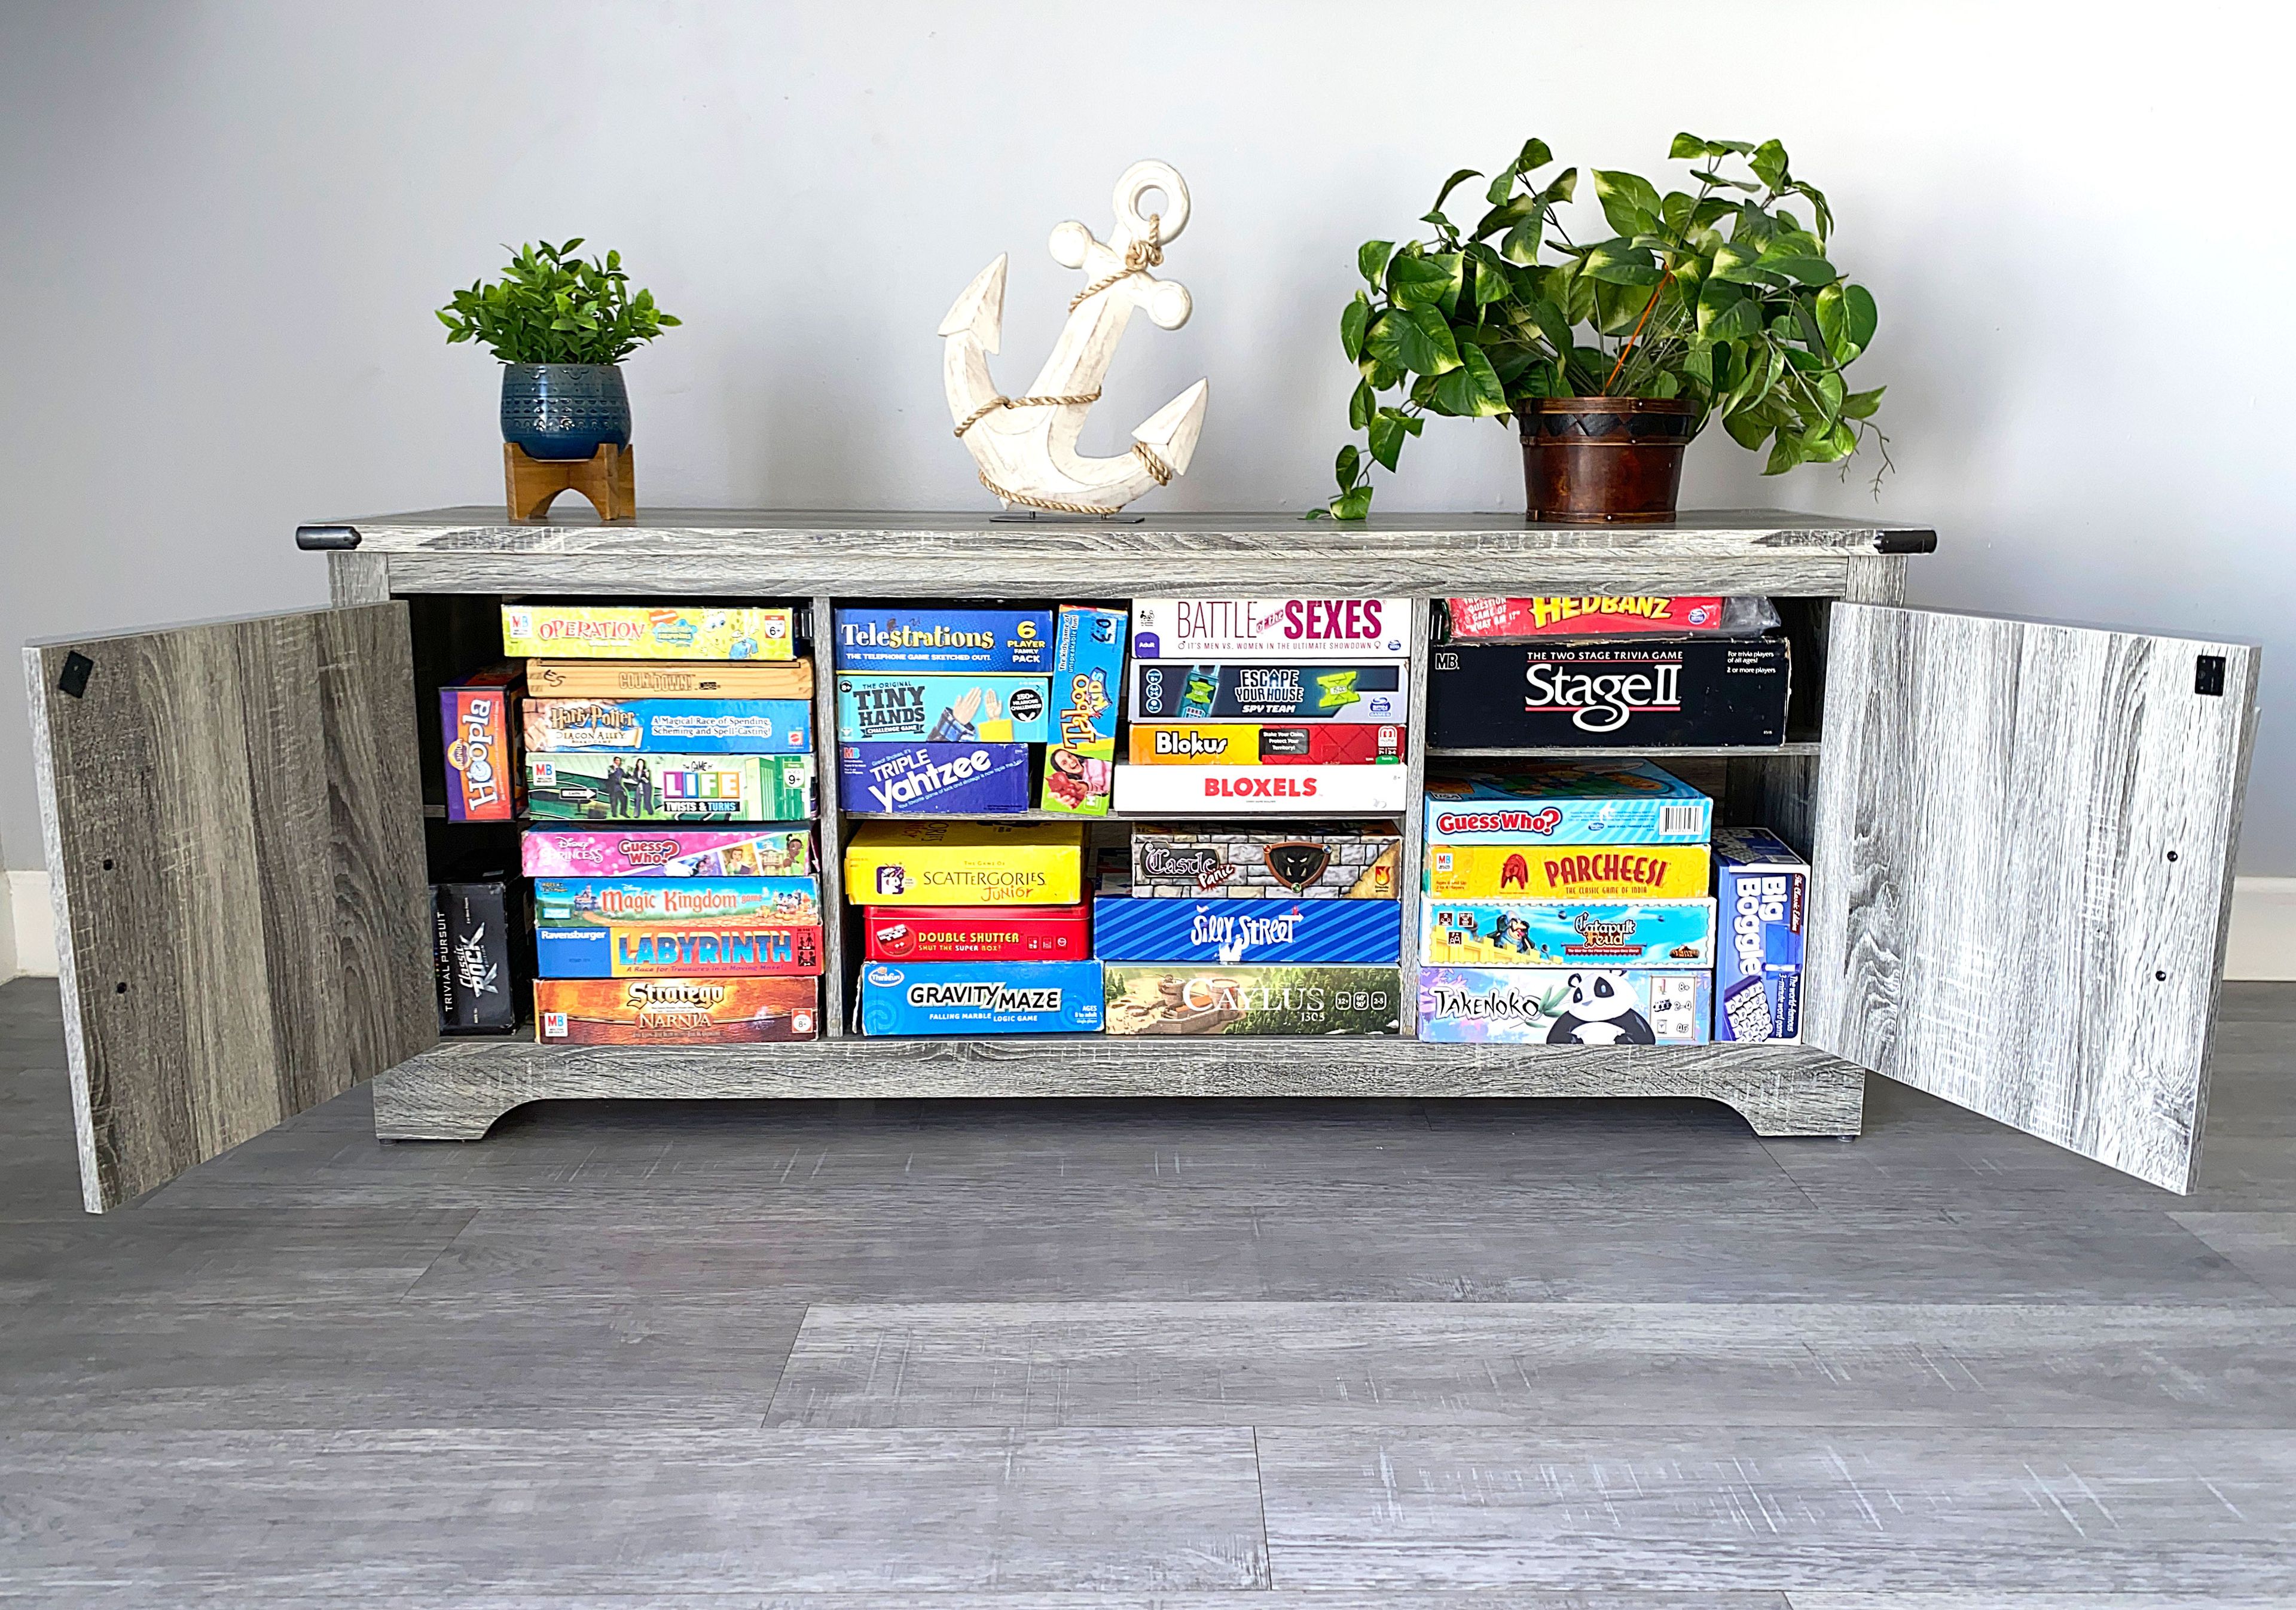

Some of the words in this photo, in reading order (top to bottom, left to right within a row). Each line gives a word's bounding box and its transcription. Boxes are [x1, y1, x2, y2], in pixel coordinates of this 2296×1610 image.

[1177, 601, 1257, 638] BATTLE
[1284, 599, 1382, 640] SEXES
[1495, 604, 1507, 615] OF
[1528, 597, 1672, 629] HEDBANZ
[512, 615, 529, 628] MB
[539, 619, 645, 638] OPERATION
[769, 626, 781, 636] 6+
[1016, 621, 1037, 639] 6
[841, 622, 995, 649] Telestrations
[1068, 631, 1077, 673] unspeakable
[1527, 652, 1547, 660] THE
[1550, 652, 1575, 660] TWO
[1578, 651, 1611, 660] STAGE
[1614, 651, 1648, 660] TRIVIA
[1651, 650, 1683, 659] GAME
[1241, 670, 1299, 688] ESCAPE
[853, 686, 926, 710] TINY
[1236, 688, 1265, 701] YOUR
[1267, 688, 1303, 701] HOUSE
[1525, 663, 1652, 732] Stage
[858, 707, 926, 726] HANDS
[1060, 673, 1095, 749] Taboo
[1242, 704, 1263, 713] SPY
[1266, 704, 1296, 713] TEAM
[551, 707, 590, 731] Harry
[590, 704, 635, 734] Potter
[661, 717, 694, 726] Magical
[654, 727, 694, 736] Scheming
[867, 726, 899, 734] CHALLENGE
[462, 698, 498, 811] Hoopla
[844, 747, 860, 759] MB
[1156, 731, 1228, 758] Blokus
[536, 764, 553, 776] MB
[869, 749, 932, 782] TRIPLE
[664, 772, 739, 797] LIFE
[788, 775, 801, 785] 9+
[868, 750, 991, 813] Yahtzee
[963, 776, 981, 786] strategy
[1204, 777, 1318, 797] BLOXELS
[665, 802, 697, 812] TWISTS
[698, 802, 707, 812] &
[707, 802, 737, 812] TURNS
[1439, 814, 1500, 832] Guess
[1500, 809, 1561, 833] Who?
[621, 841, 662, 853] Guess
[1144, 843, 1216, 875] Castle
[1438, 855, 1451, 864] MB
[923, 871, 1046, 886] SCATTERGORIES
[1198, 864, 1234, 888] Panic
[1543, 854, 1669, 888] PARCHEESI
[1794, 873, 1803, 887] The
[601, 890, 656, 913] Magic
[664, 888, 737, 913] Kingdom
[1757, 876, 1788, 922] Big
[1793, 887, 1802, 911] Classic
[1574, 912, 1636, 934] Catapult
[1734, 877, 1764, 976] Boggle
[1791, 910, 1801, 932] Edition
[436, 912, 450, 963] PURSUIT
[541, 930, 606, 941] Ravensburger
[918, 931, 966, 943] DOUBLE
[970, 931, 1019, 943] SHUTTER
[1584, 931, 1625, 947] Feud
[619, 931, 792, 965] LABYRINTH
[453, 944, 474, 989] Classic
[459, 921, 499, 998] ROCK
[442, 964, 453, 1012] TRIVIAL
[1678, 982, 1690, 992] 8+
[1778, 973, 1787, 1003] 3-minute
[1789, 975, 1799, 988] The
[627, 982, 725, 1010] Stratego
[910, 985, 1001, 1006] GRAVITY
[998, 991, 1059, 1010] MAZE
[1182, 977, 1324, 1012] CAYLUS
[1434, 989, 1540, 1019] TAKENOKO
[1674, 1000, 1692, 1012] 2-4
[1776, 1003, 1785, 1021] word
[1787, 987, 1797, 1032] world-famous
[547, 1015, 564, 1027] MB
[639, 1013, 712, 1031] NARNIA
[1300, 1012, 1326, 1022] 1303
[1676, 1022, 1690, 1034] 45
[1775, 1019, 1784, 1038] game
